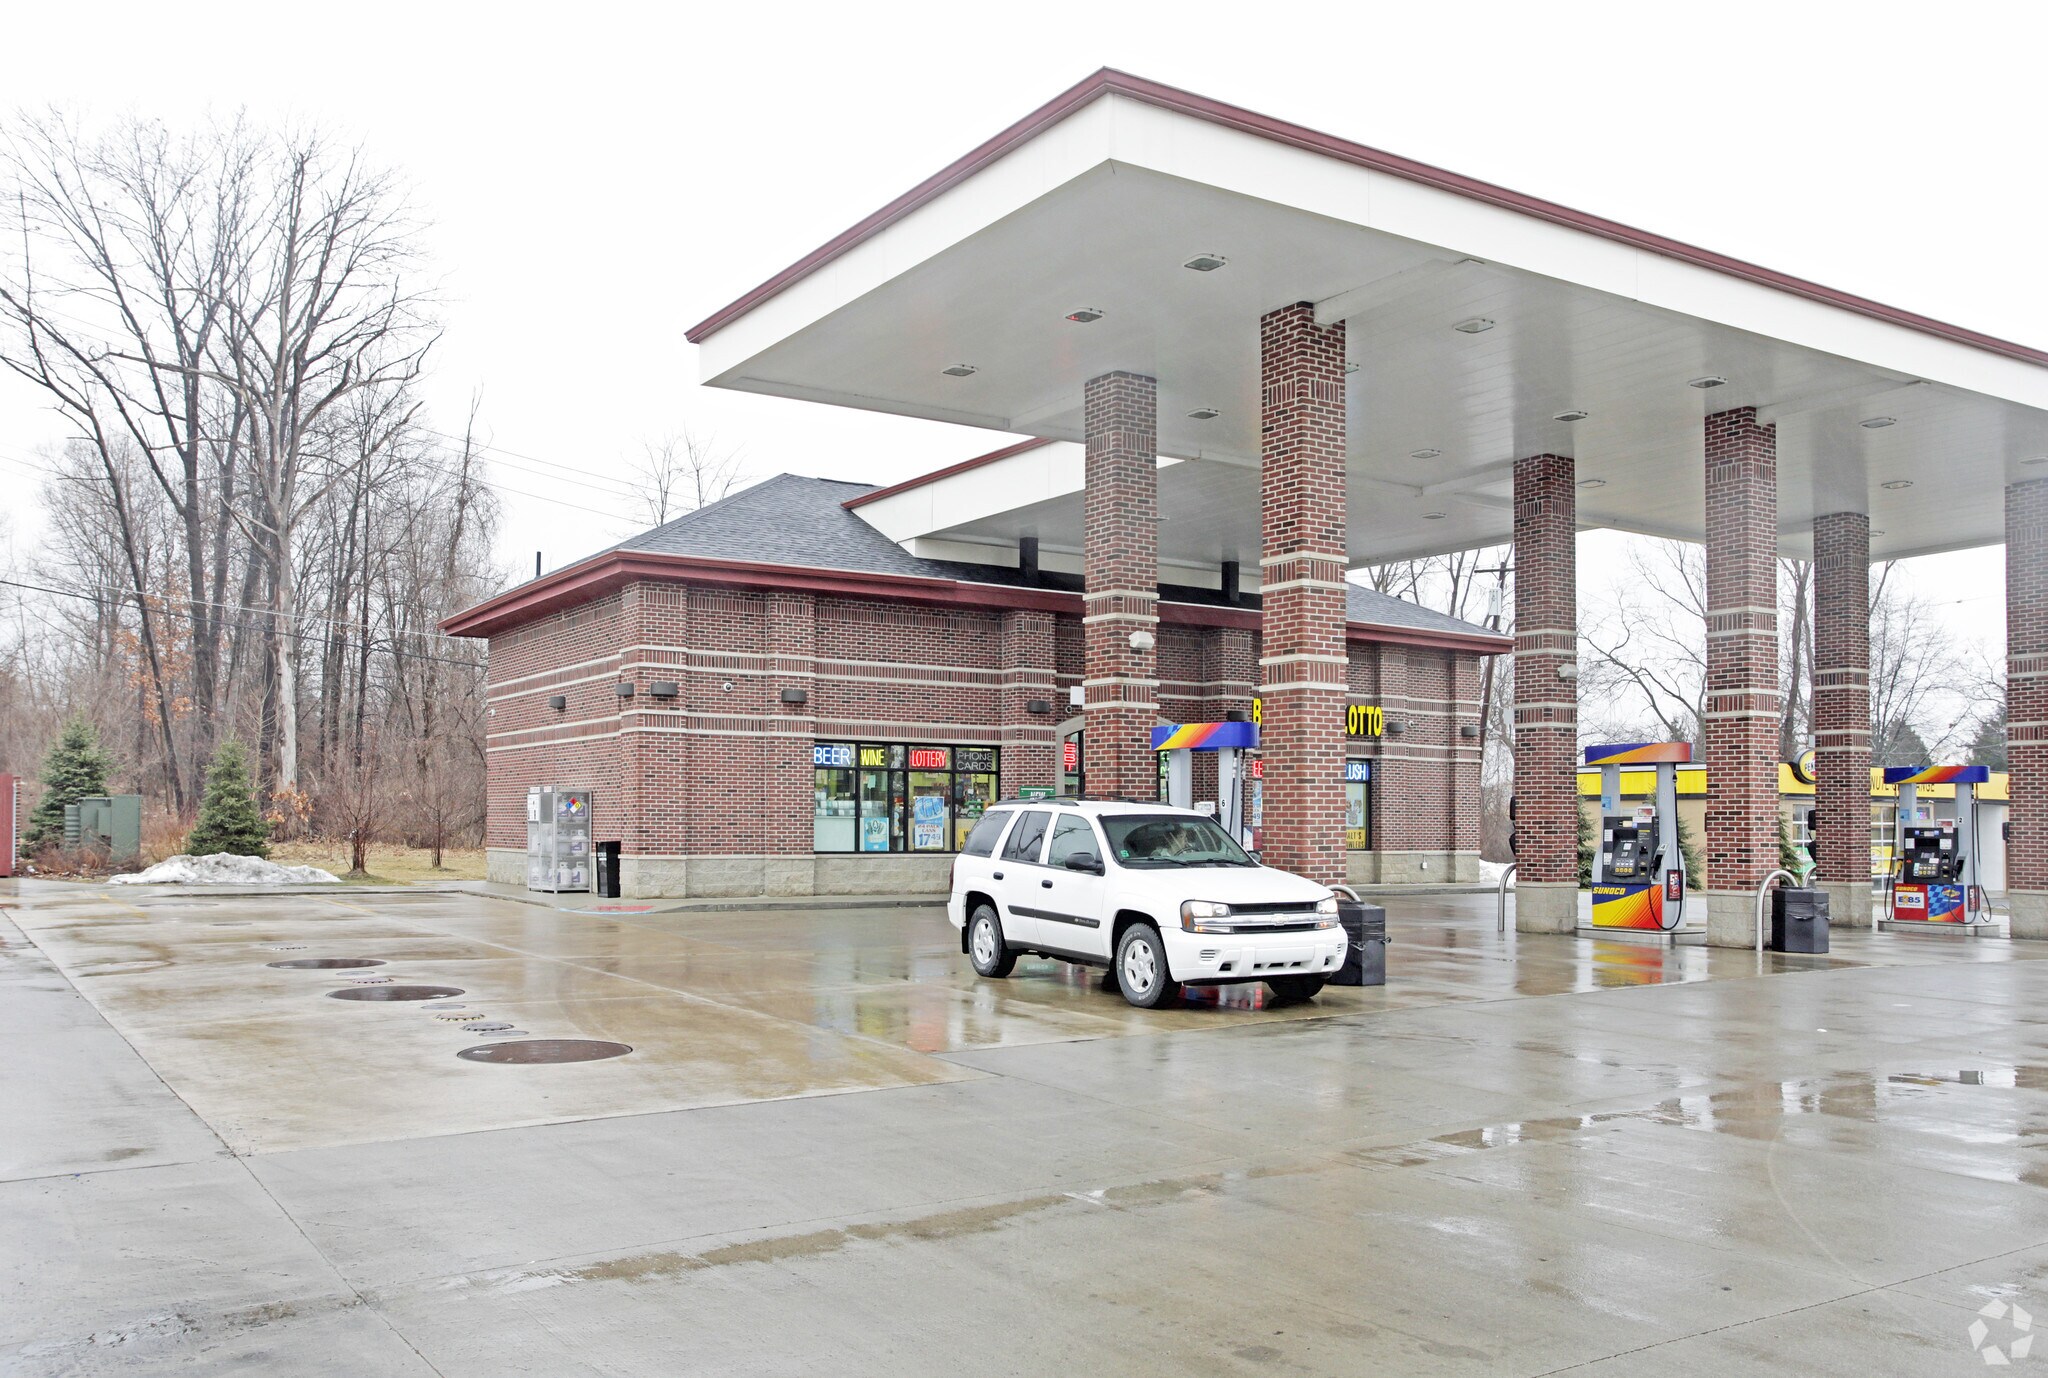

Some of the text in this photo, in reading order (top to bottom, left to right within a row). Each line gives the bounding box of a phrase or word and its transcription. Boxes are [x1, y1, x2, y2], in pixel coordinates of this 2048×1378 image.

[1345, 704, 1383, 737] OTTO
[814, 747, 851, 765] BEER
[860, 748, 885, 766] WINE
[911, 750, 946, 768] LOTTERY
[957, 751, 993, 761] PHONE
[1064, 743, 1077, 772] EBT
[957, 761, 993, 771] CARDS
[1345, 763, 1366, 780] USH
[1222, 799, 1226, 807] 6
[1592, 886, 1626, 896] SUNOCO
